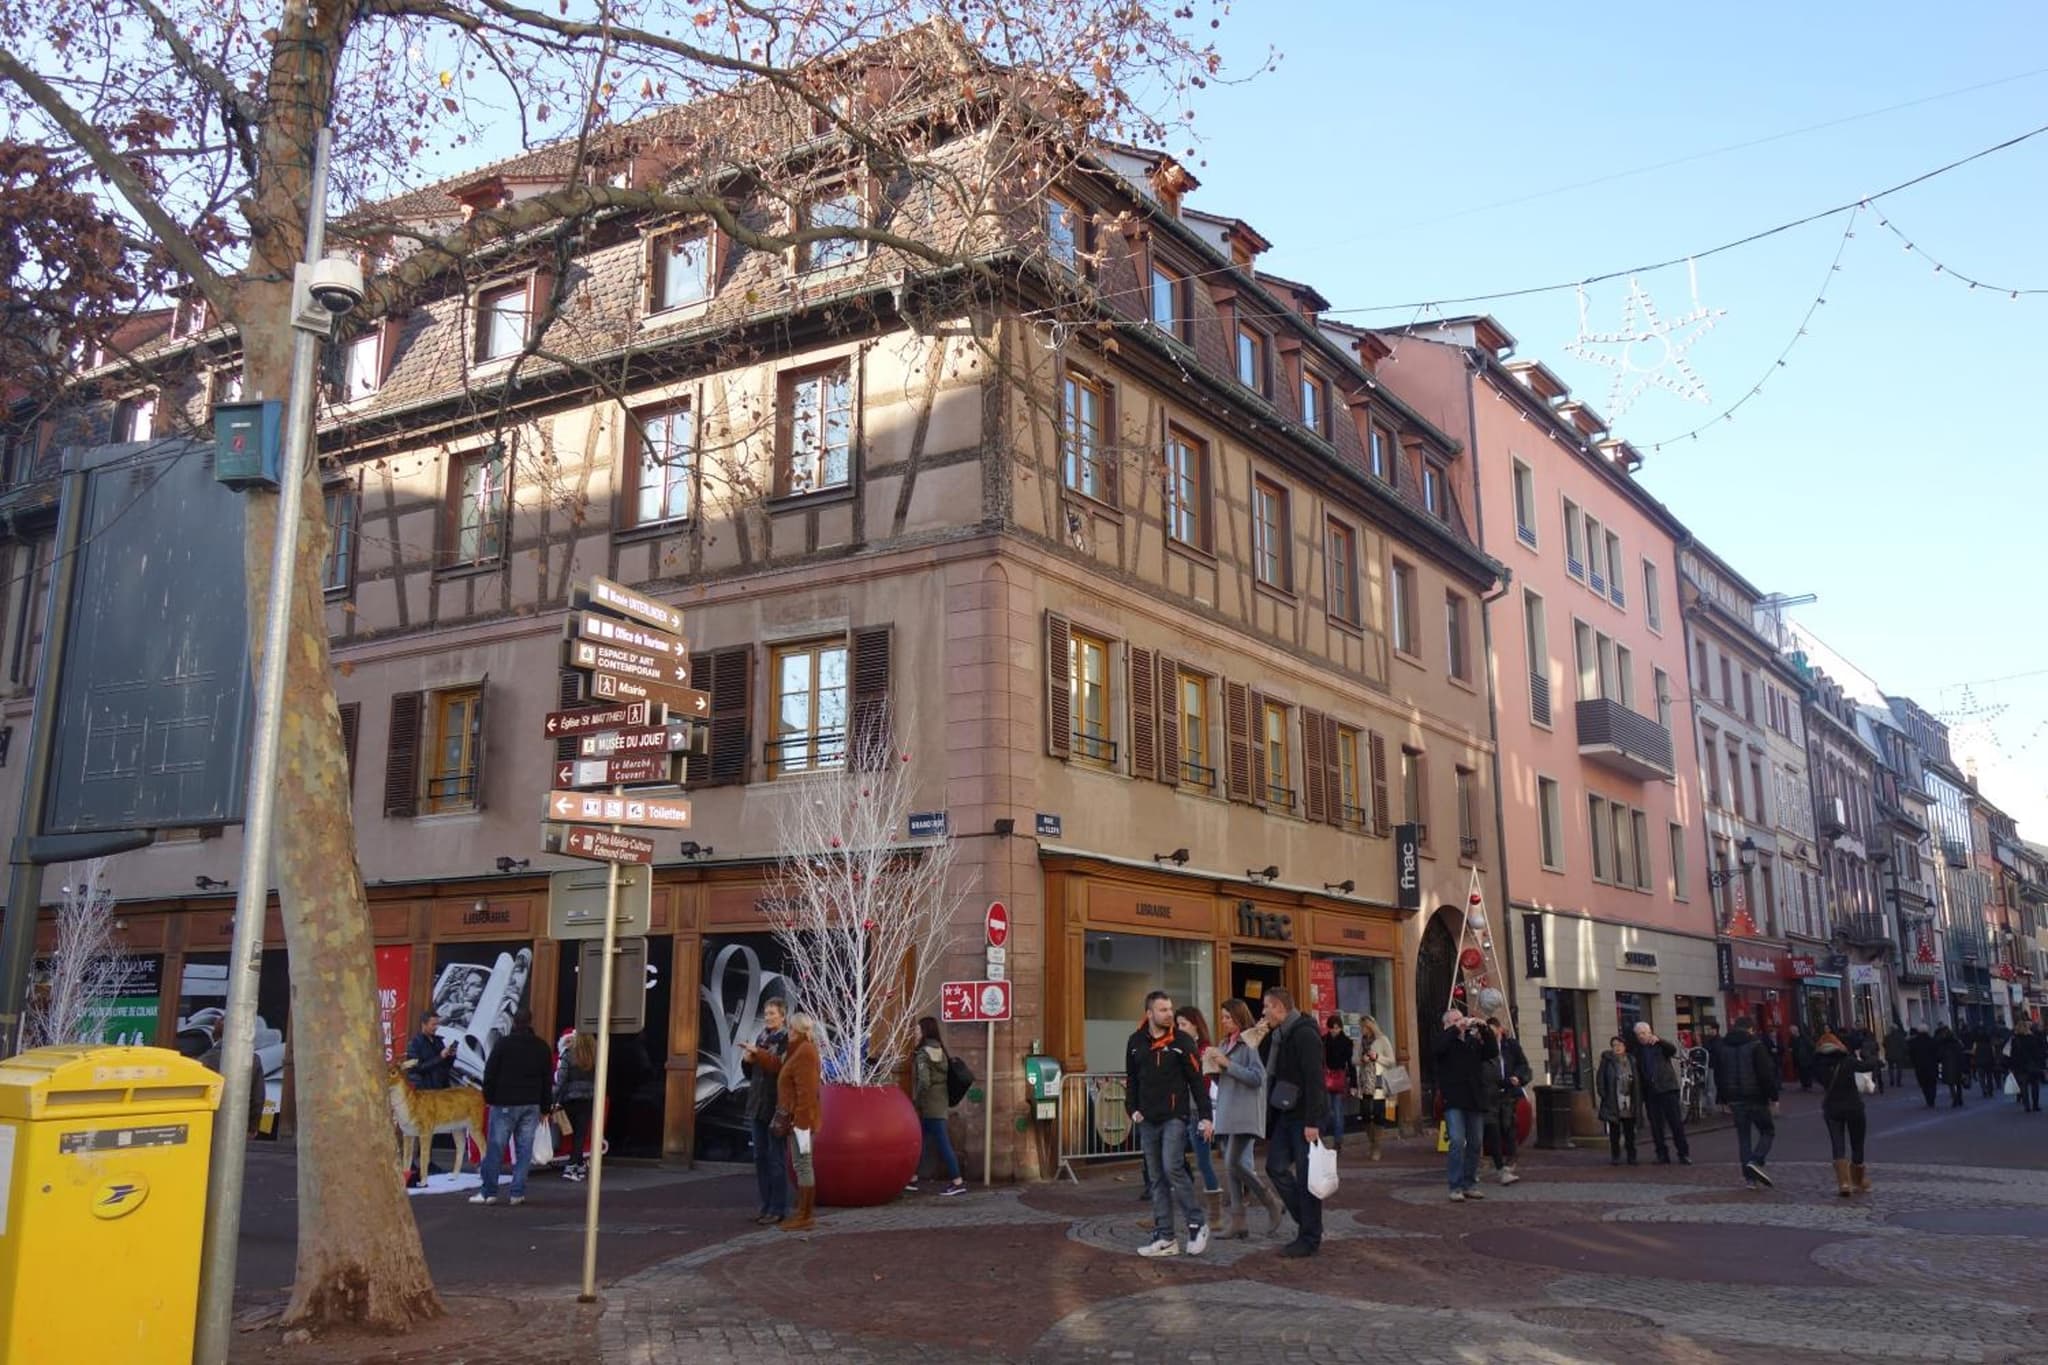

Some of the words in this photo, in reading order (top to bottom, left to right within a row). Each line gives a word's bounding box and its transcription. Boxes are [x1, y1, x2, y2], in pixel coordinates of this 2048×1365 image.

[598, 647, 628, 662] ESPACE
[641, 657, 655, 667] ART
[598, 659, 660, 678] CONTEMPORAIN
[618, 682, 647, 697] Mairie
[592, 710, 626, 725] MATTHIEU
[598, 735, 625, 751] MUSÉE
[626, 736, 639, 748] DU
[640, 732, 665, 746] JOUET
[622, 757, 651, 769] Marché
[615, 771, 646, 781] Couvert
[648, 806, 687, 821] Toilettes
[1401, 843, 1416, 890] fnac
[1136, 903, 1172, 919] LIBRAIRIE
[1238, 900, 1291, 941] fnac
[1530, 922, 1539, 969] SEPHORA
